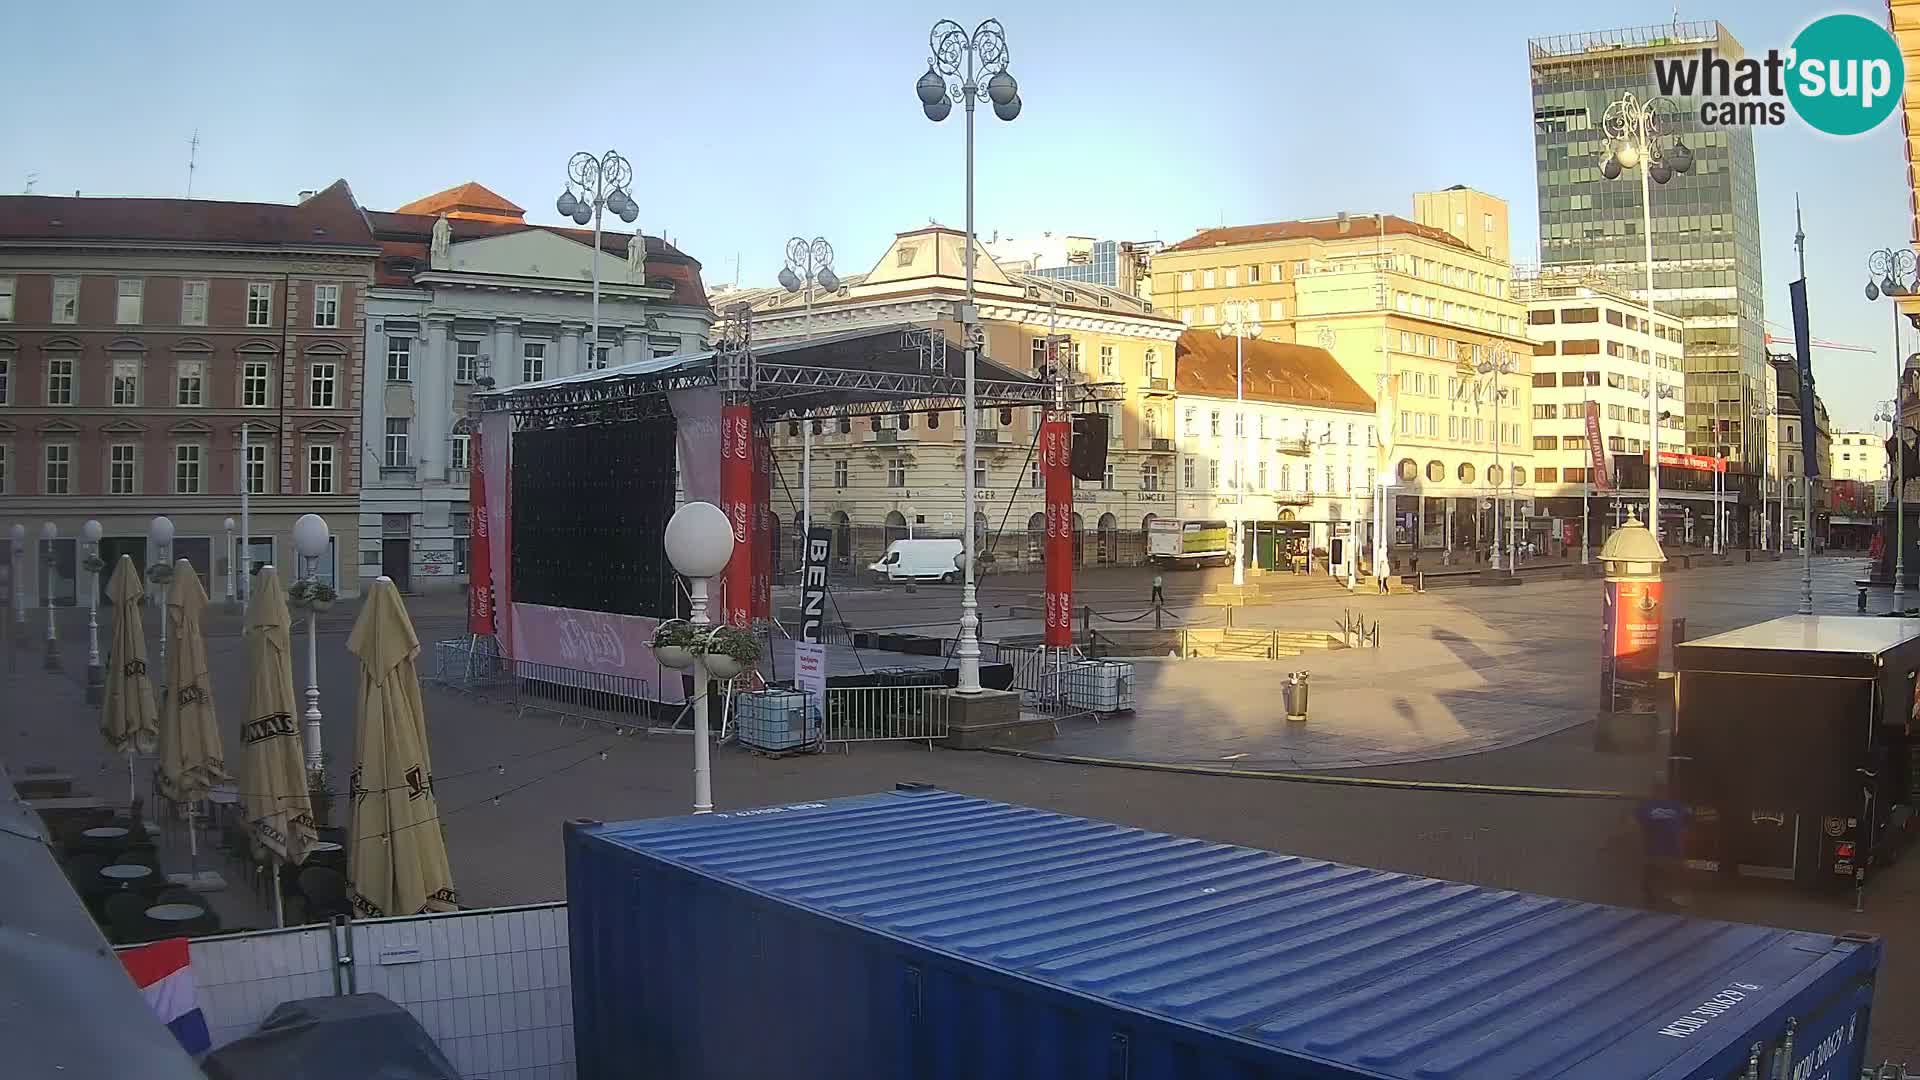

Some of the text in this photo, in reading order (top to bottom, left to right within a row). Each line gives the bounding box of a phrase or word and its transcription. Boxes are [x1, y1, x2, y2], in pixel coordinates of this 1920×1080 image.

[1137, 492, 1167, 502] SINGER
[803, 539, 828, 643] BENU
[1658, 1015, 1708, 1039] MCDU
[1697, 988, 1746, 1018] 300629
